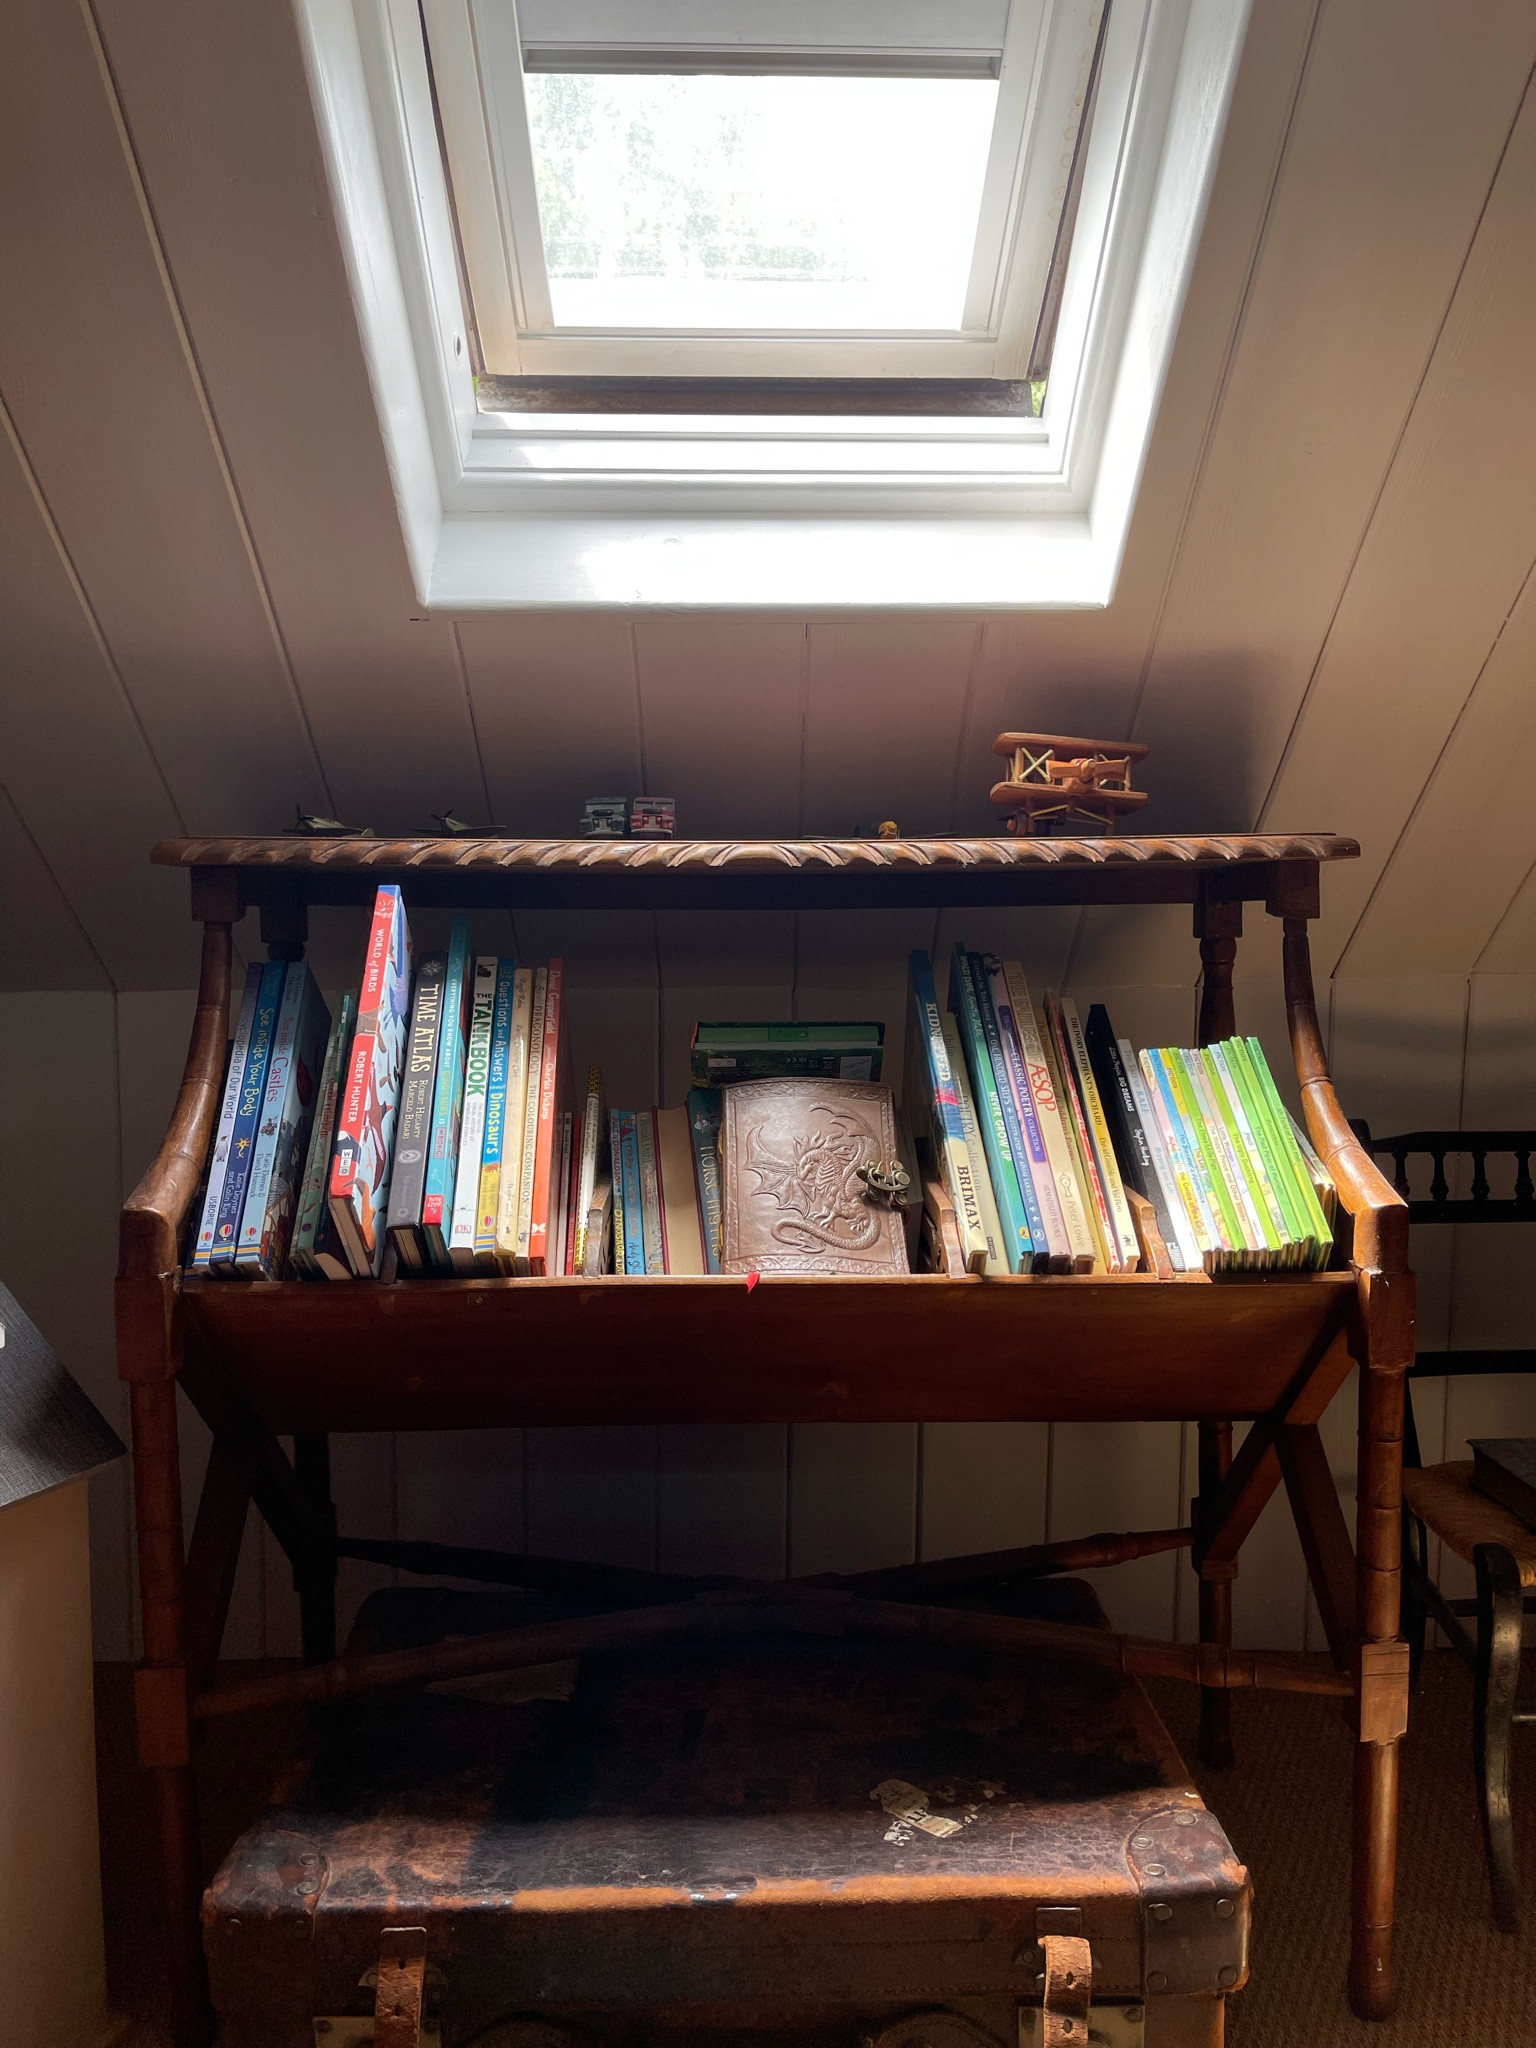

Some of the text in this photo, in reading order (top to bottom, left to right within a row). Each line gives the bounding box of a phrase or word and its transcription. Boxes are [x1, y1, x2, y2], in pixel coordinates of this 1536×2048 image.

[373, 929, 385, 957] WORLD
[368, 969, 379, 992] BIRDS
[449, 979, 457, 1013] EVERYTHING
[1008, 973, 1027, 997] THE
[260, 1008, 274, 1027] See
[497, 981, 510, 1028] Questions
[546, 970, 560, 1034] David Copperfield
[283, 1017, 293, 1032] See
[410, 984, 440, 1073] TIME ATLAS
[253, 1030, 271, 1060] inside
[467, 1000, 492, 1097] TANK BOOK
[492, 1040, 508, 1082] Answers
[1216, 1051, 1227, 1072] FICTION
[1226, 1047, 1237, 1068] FICTION
[1237, 1041, 1248, 1062] FICTION
[247, 1060, 265, 1086] Your
[267, 1057, 289, 1102] Castles
[990, 1040, 1011, 1104] ONE HUNDRED STEPS
[1073, 1029, 1084, 1049] IVORY
[1089, 1091, 1102, 1125] ORCHARD
[1143, 1056, 1154, 1078] FICTION
[1166, 1067, 1178, 1088] FICTION
[1175, 1053, 1187, 1074] FICTION
[1184, 1054, 1195, 1076] FICTION
[1193, 1053, 1205, 1075] FICTION
[1204, 1053, 1216, 1076] FICTION
[224, 1065, 240, 1119] of Our World
[240, 1087, 261, 1116] Body
[348, 1051, 366, 1123] ROBERT HUNTER
[440, 1071, 450, 1115] DINOSAURS
[522, 1005, 543, 1204] DRAGONOLOGY THE COLOURING COMPANION
[540, 1063, 554, 1120] Charles Dickens
[1011, 1052, 1040, 1151] CLASSIC POETRY COLLECTION
[1118, 1077, 1135, 1112] BIG DREAMS
[486, 1092, 504, 1154] Dinosaurs
[989, 1091, 1012, 1161] NEVER GROW UP
[1196, 1118, 1204, 1128] The
[1200, 1129, 1208, 1142] Three
[1065, 1137, 1075, 1161] Poems
[1100, 1137, 1109, 1155] David
[1105, 1155, 1115, 1177] Gamble
[1219, 1127, 1235, 1162] Little Women
[613, 1141, 621, 1186] DONALDSON
[966, 1139, 981, 1190] Collection
[1213, 1136, 1222, 1153] Happy
[1219, 1153, 1229, 1172] Prince
[1226, 1173, 1234, 1184] and
[1230, 1184, 1239, 1200] Other
[1236, 1202, 1246, 1222] Stories
[1237, 1144, 1246, 1157] Ugly
[1243, 1158, 1255, 1184] Duckling
[957, 1166, 980, 1230] BRIMAX
[1183, 1182, 1192, 1200] Centre
[205, 1196, 218, 1226] USBORNE
[1067, 1201, 1085, 1247] Peter Lowe
[456, 1225, 470, 1233] DK
